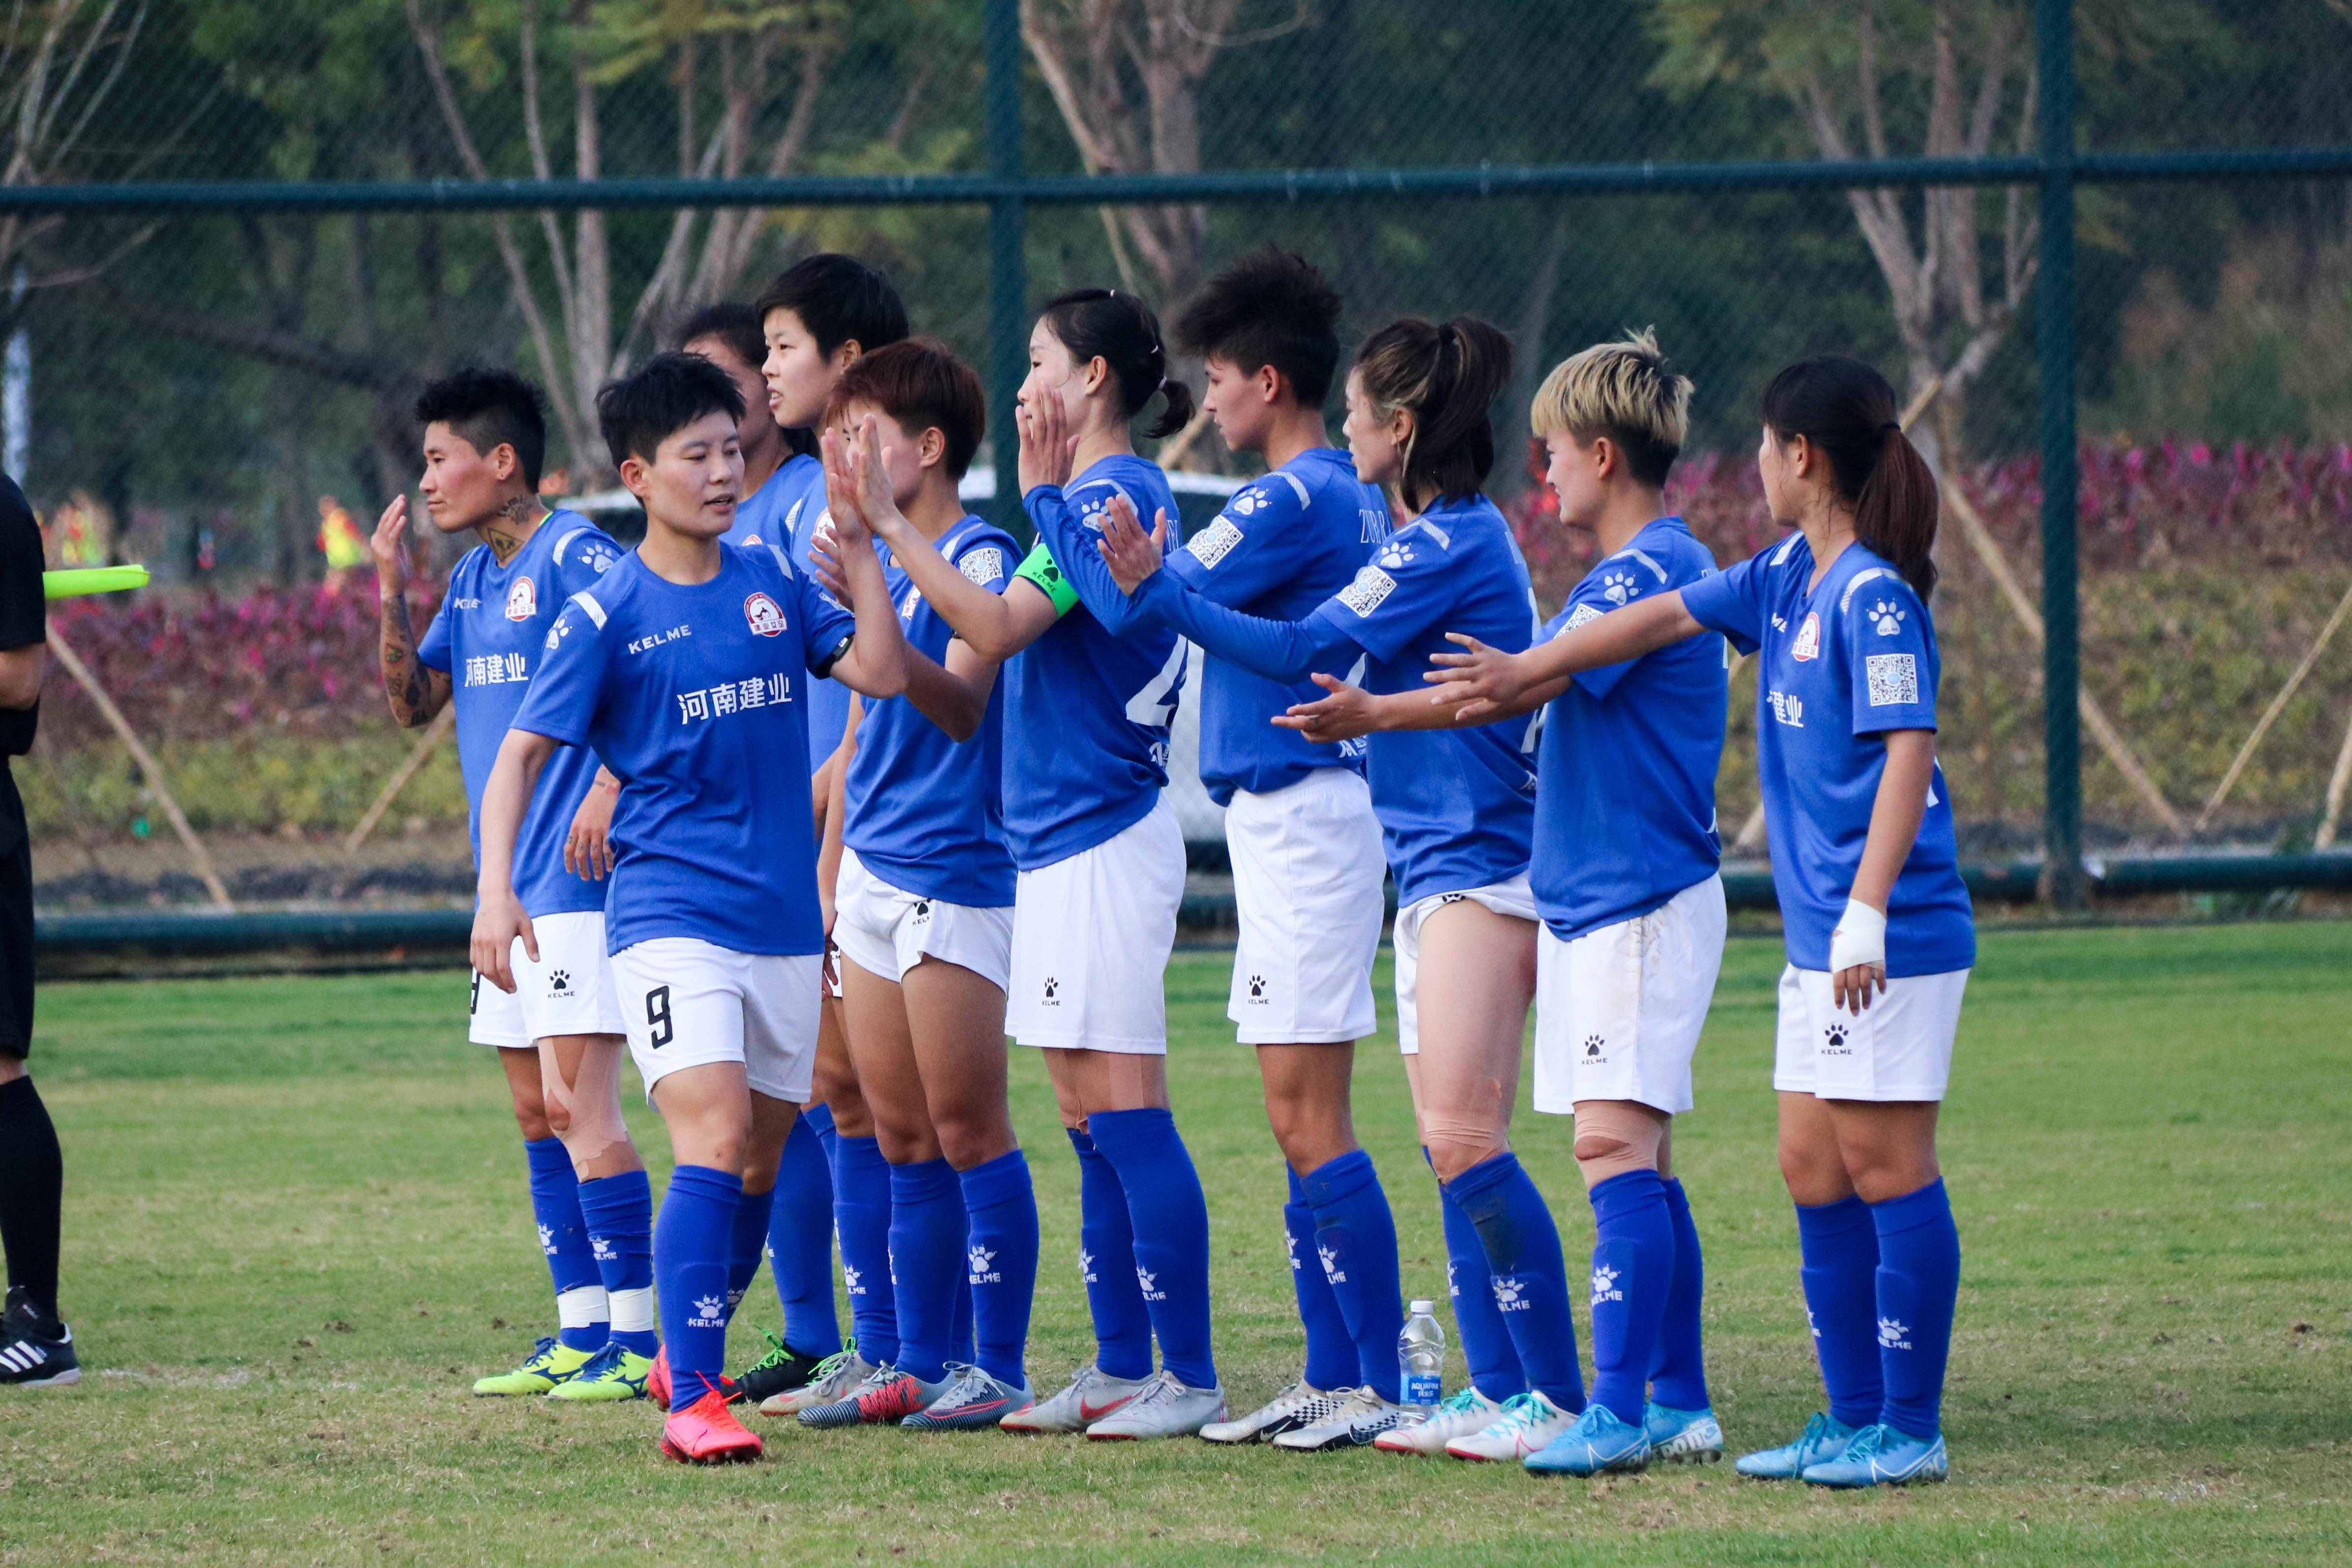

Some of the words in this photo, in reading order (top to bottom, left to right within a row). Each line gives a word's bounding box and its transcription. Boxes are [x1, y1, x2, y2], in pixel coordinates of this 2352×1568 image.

[1032, 571, 1056, 593] KELME
[628, 624, 692, 654] KELME
[676, 672, 793, 725] 河南建业
[1766, 690, 1804, 728] 建业
[547, 991, 574, 999] KELME
[646, 985, 673, 1050] 9
[1582, 1057, 1608, 1066] KELME
[594, 1251, 618, 1260] ELME
[1327, 1271, 1347, 1284] LME
[847, 1286, 867, 1295] LME
[1497, 1299, 1531, 1312] ELME
[687, 1317, 725, 1328] KELME
